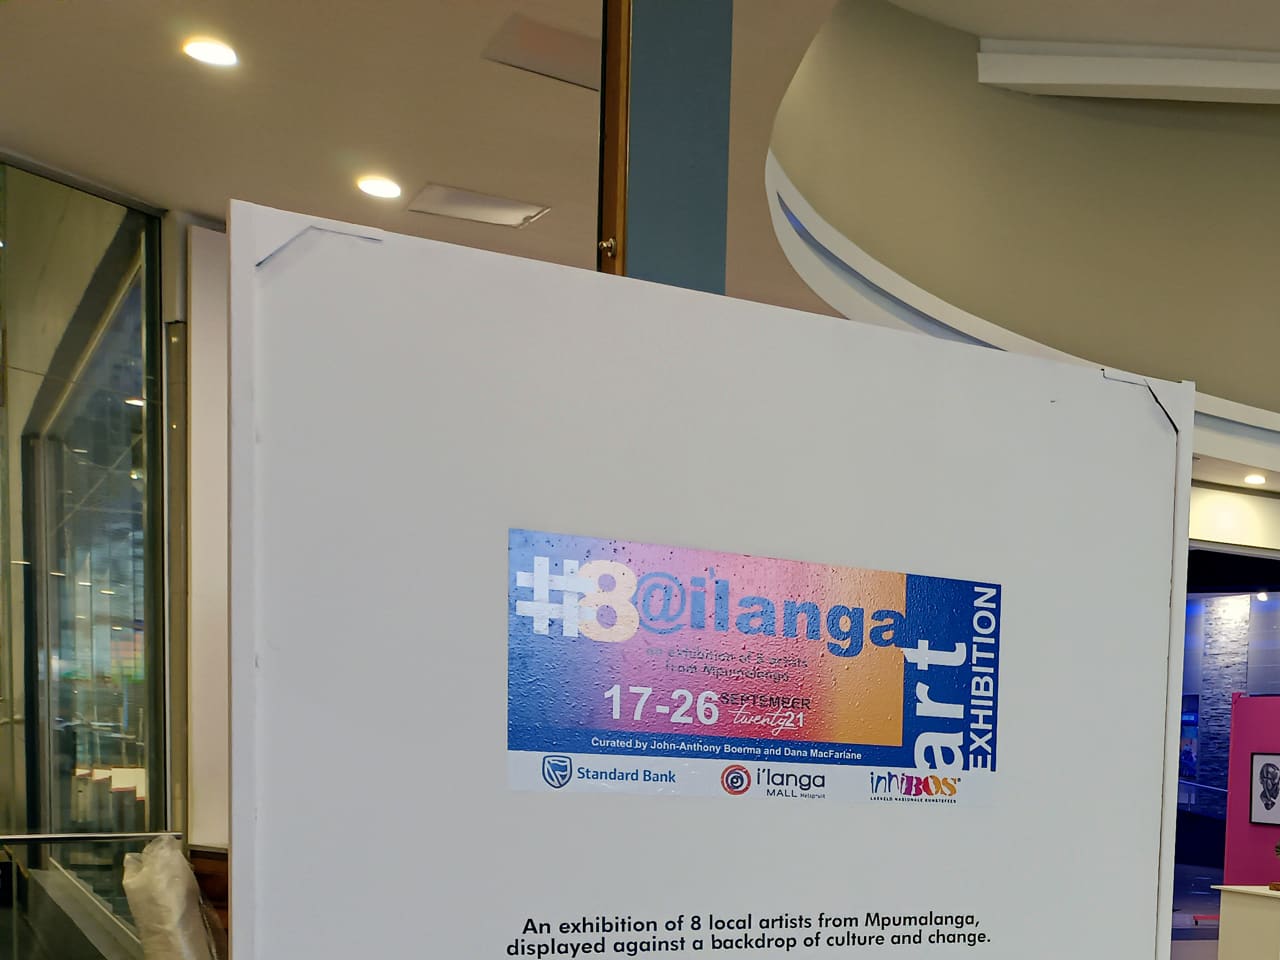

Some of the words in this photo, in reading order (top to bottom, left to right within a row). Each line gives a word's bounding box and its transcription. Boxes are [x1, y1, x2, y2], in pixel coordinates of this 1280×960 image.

[969, 585, 997, 771] EXHIBITION
[603, 684, 720, 724] 17-26
[902, 639, 967, 771] art
[591, 737, 632, 749] Curated
[635, 740, 647, 751] by
[650, 740, 720, 754] John-Anthony
[724, 744, 760, 755] Boerma
[763, 746, 781, 756] and
[784, 747, 808, 757] Dana
[810, 749, 862, 760] MacFarlane
[577, 766, 639, 781] Standard
[643, 770, 676, 783] Bank
[766, 789, 798, 798] MALL
[522, 918, 551, 935] An
[558, 915, 658, 934] exhibition
[664, 914, 685, 932] of
[690, 915, 702, 931] 8
[709, 913, 752, 931] local
[758, 912, 812, 930] artists
[817, 912, 859, 928] from
[864, 910, 980, 931] Mpumalanga,
[506, 936, 606, 960] displayed
[613, 936, 686, 957] against
[692, 939, 704, 951] a
[711, 932, 797, 952] backdrop
[803, 931, 822, 948] of
[826, 930, 885, 947] culture
[890, 928, 923, 945] and
[928, 928, 991, 947] change.
